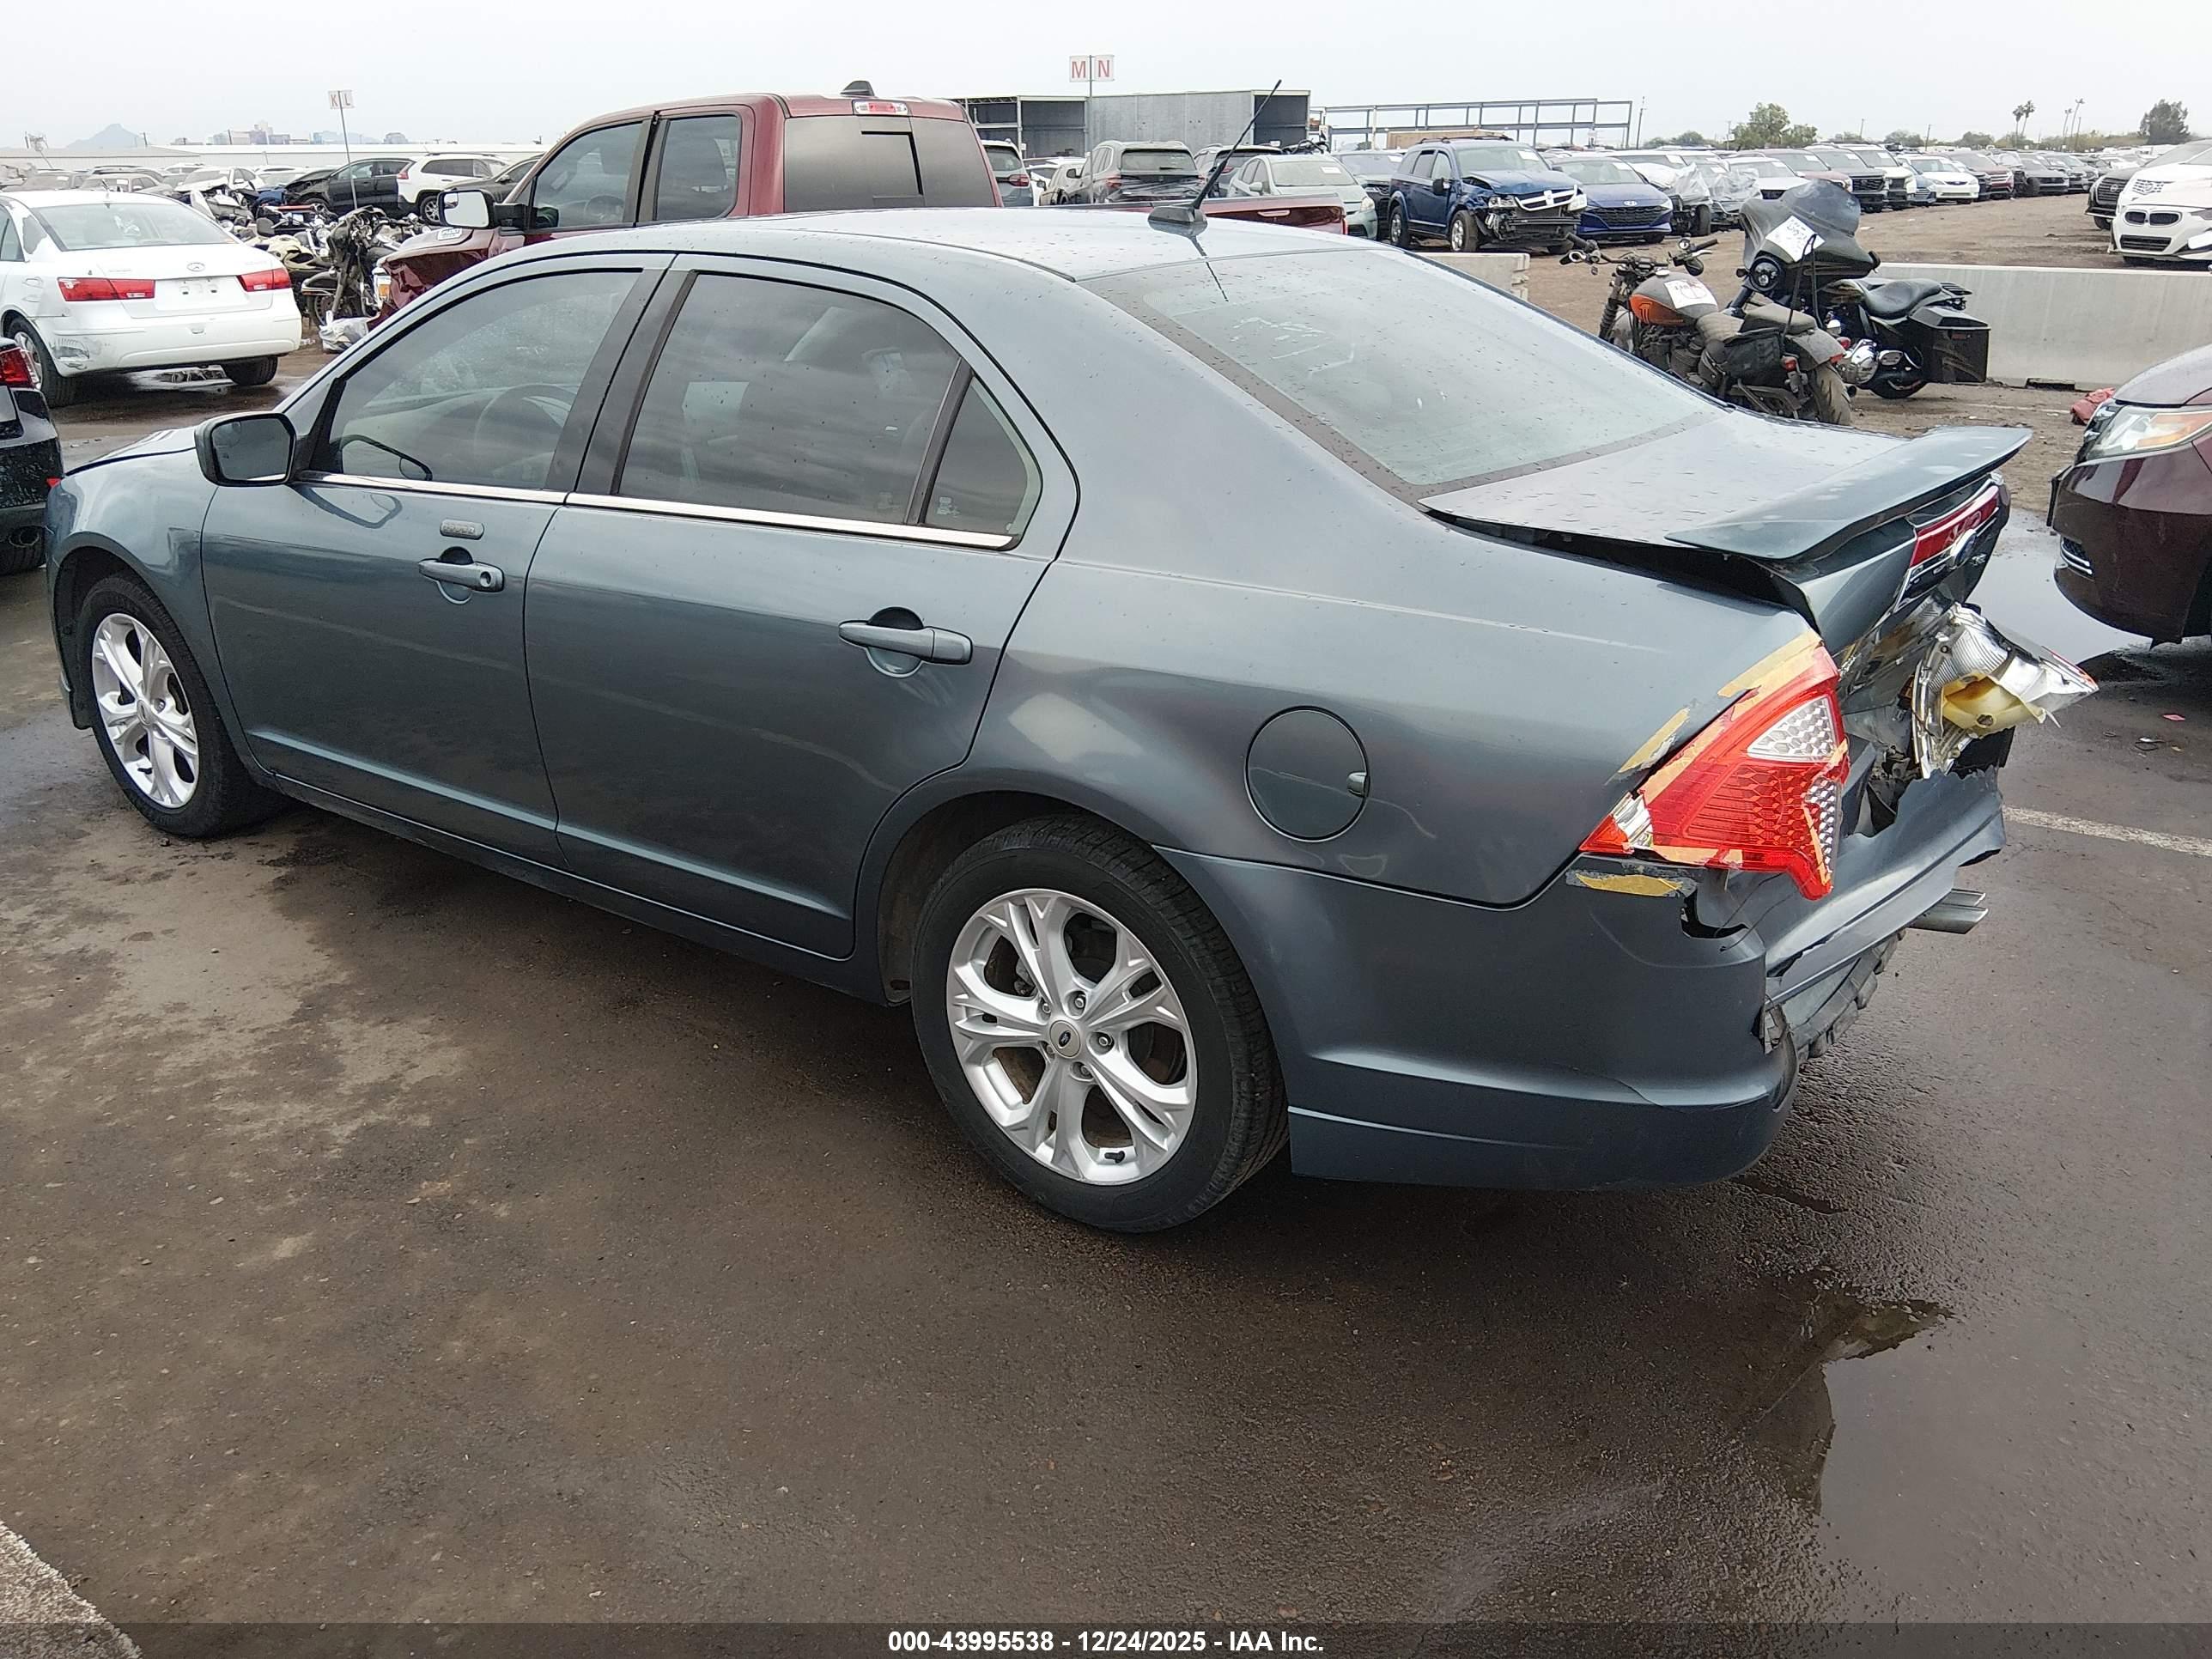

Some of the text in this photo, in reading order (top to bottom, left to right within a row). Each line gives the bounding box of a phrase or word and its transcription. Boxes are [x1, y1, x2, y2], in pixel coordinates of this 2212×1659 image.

[1071, 59, 1110, 79] M N
[330, 93, 351, 107] K L
